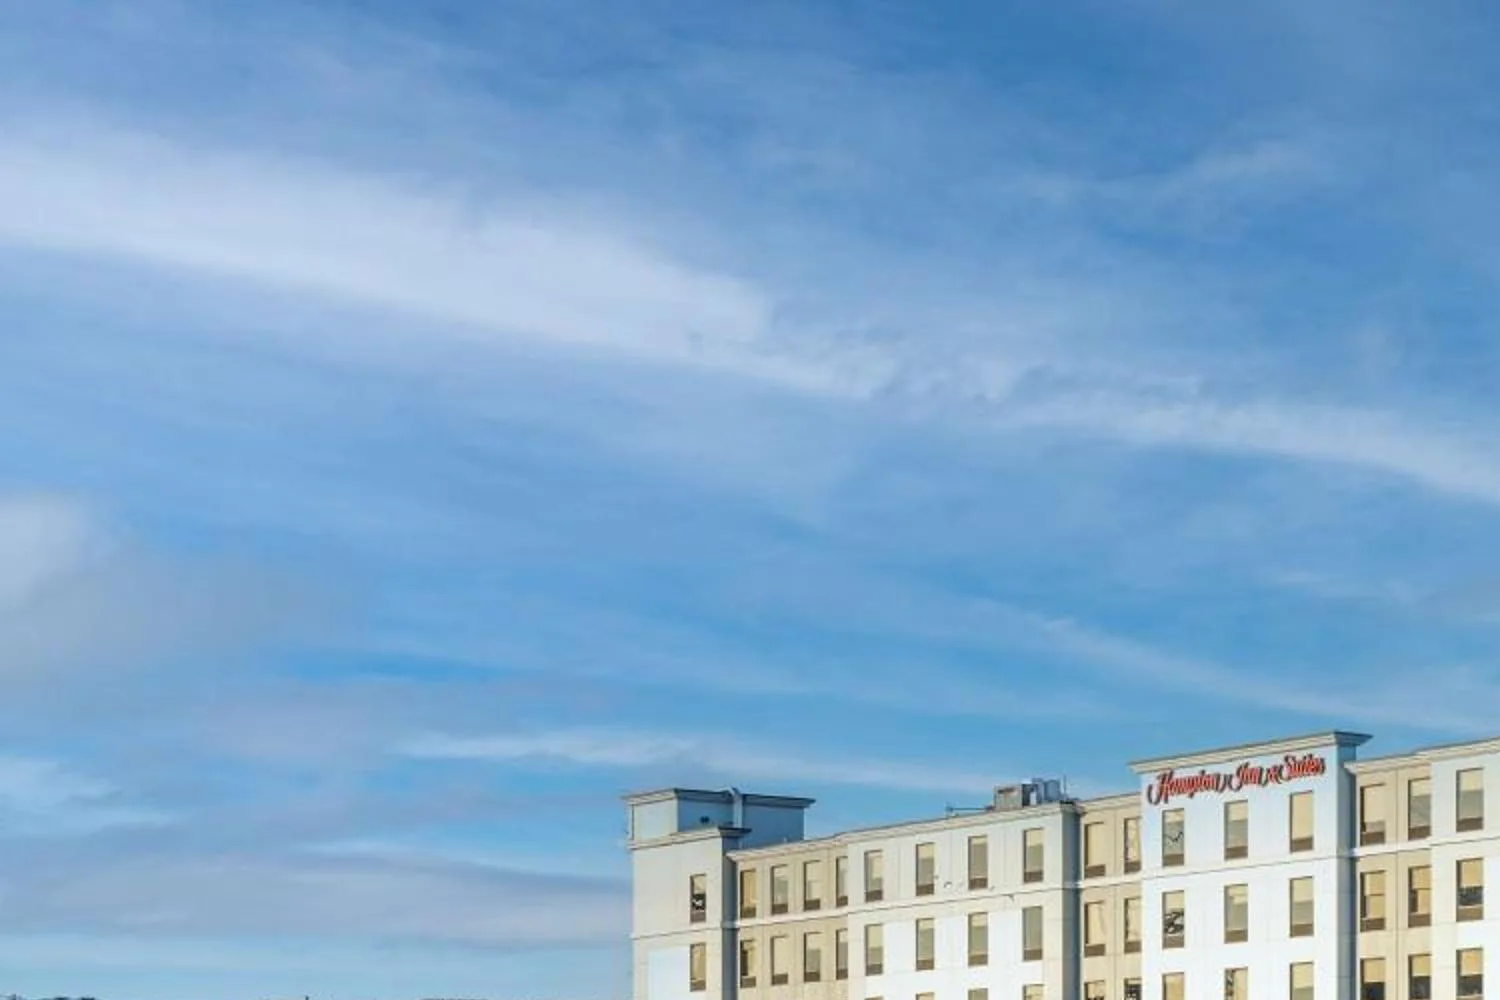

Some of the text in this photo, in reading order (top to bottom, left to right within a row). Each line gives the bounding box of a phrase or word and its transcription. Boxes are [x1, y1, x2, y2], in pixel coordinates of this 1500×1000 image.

[1147, 769, 1226, 805] Hampton
[1228, 762, 1268, 792] Inn
[1279, 753, 1326, 781] Suites
